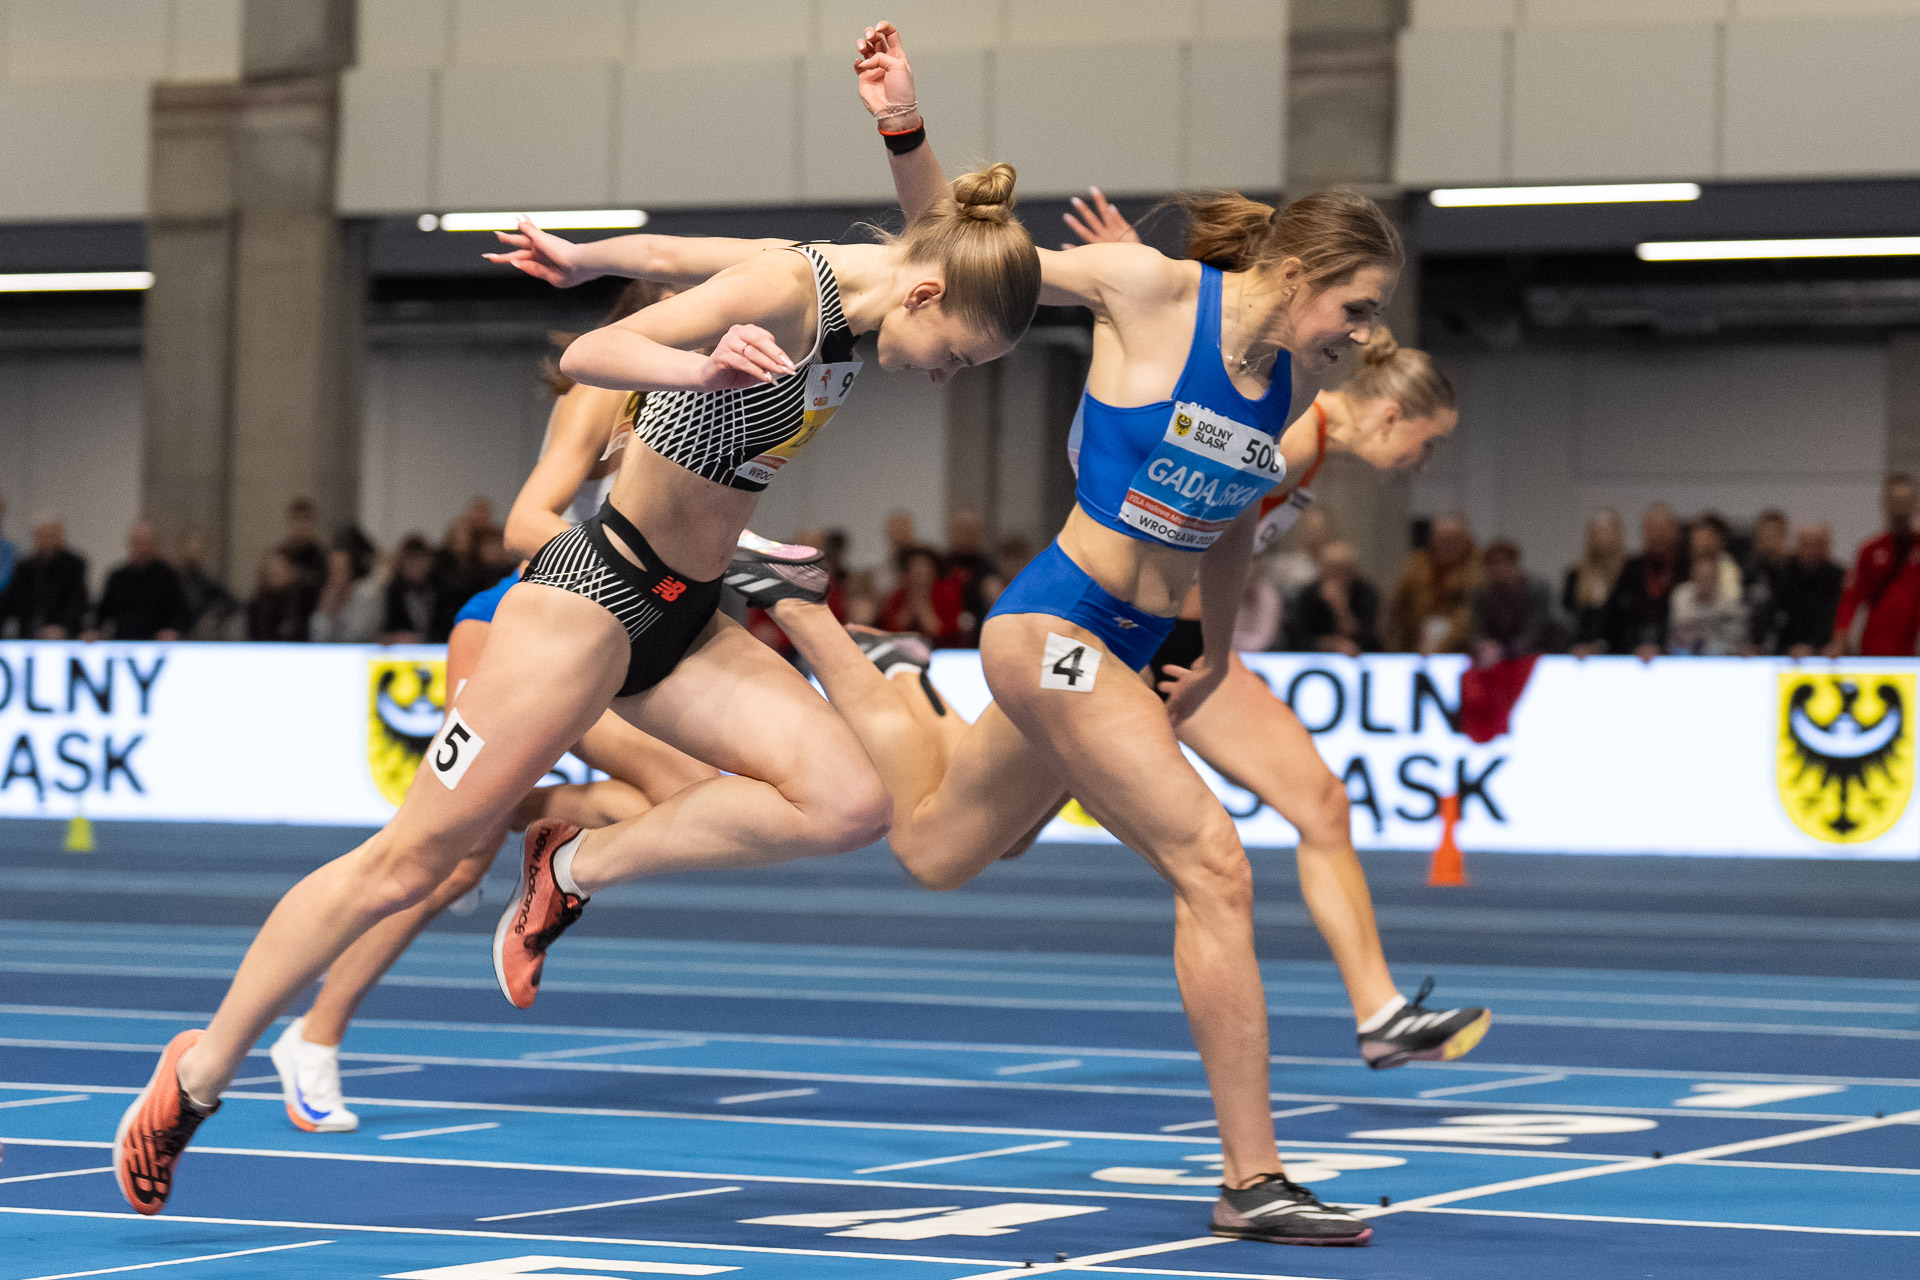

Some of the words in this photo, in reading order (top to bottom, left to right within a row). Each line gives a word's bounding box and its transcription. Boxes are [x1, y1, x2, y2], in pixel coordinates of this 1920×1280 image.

[1193, 429, 1228, 452] ŚLĄSK
[1197, 420, 1234, 442] DOLNY
[1139, 514, 1198, 543] WROCŁAW
[1052, 645, 1086, 686] 4
[435, 722, 472, 773] 5
[531, 826, 552, 864] new
[514, 863, 541, 935] balance
[1349, 1112, 1659, 1146] 2
[736, 1202, 1109, 1241] 4
